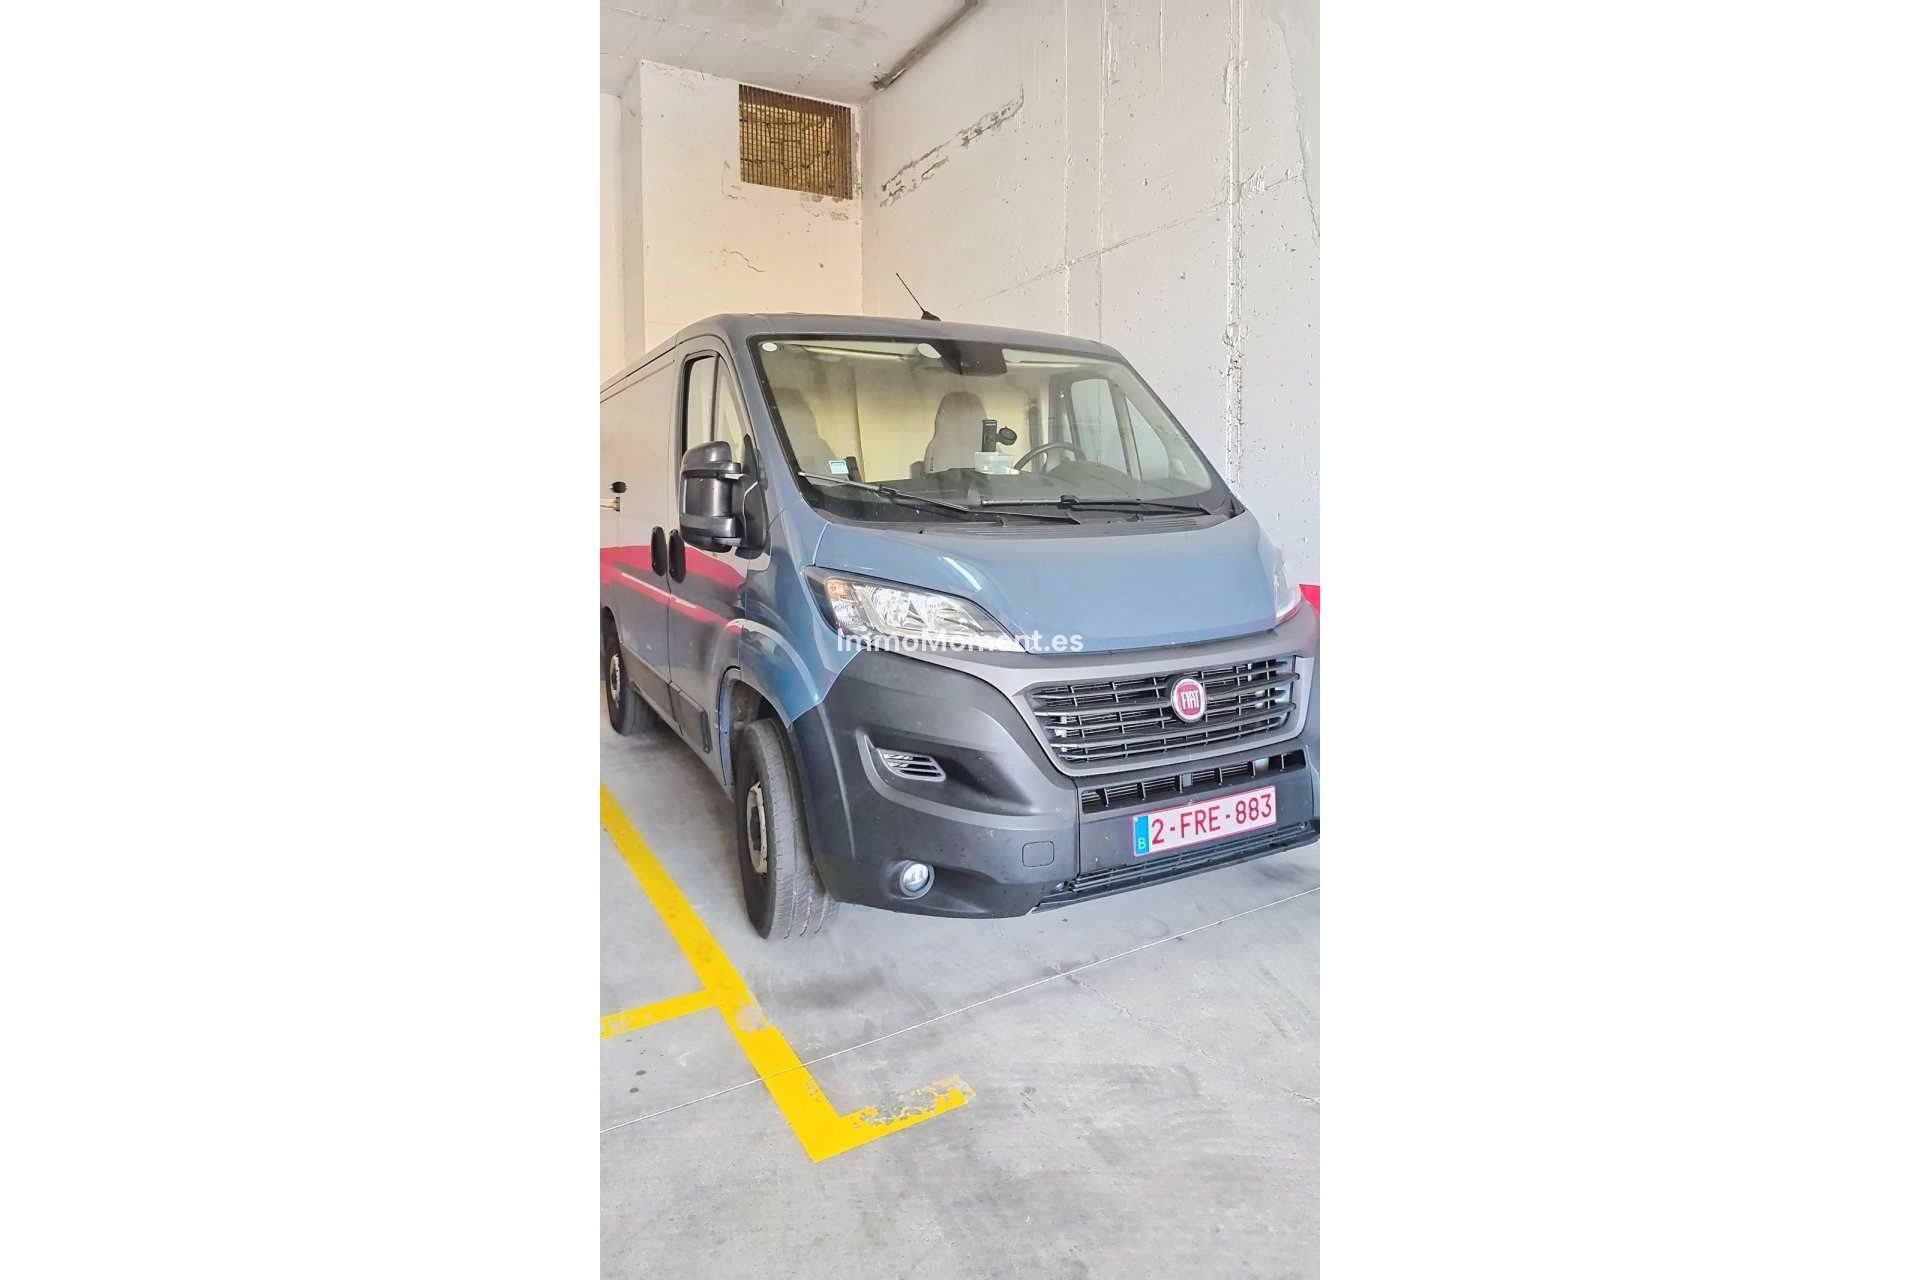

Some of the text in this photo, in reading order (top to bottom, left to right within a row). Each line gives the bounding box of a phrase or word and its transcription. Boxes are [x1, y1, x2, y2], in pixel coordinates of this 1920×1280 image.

[1181, 690, 1199, 709] FIAT
[1138, 793, 1272, 850] B 2-FRE-883
